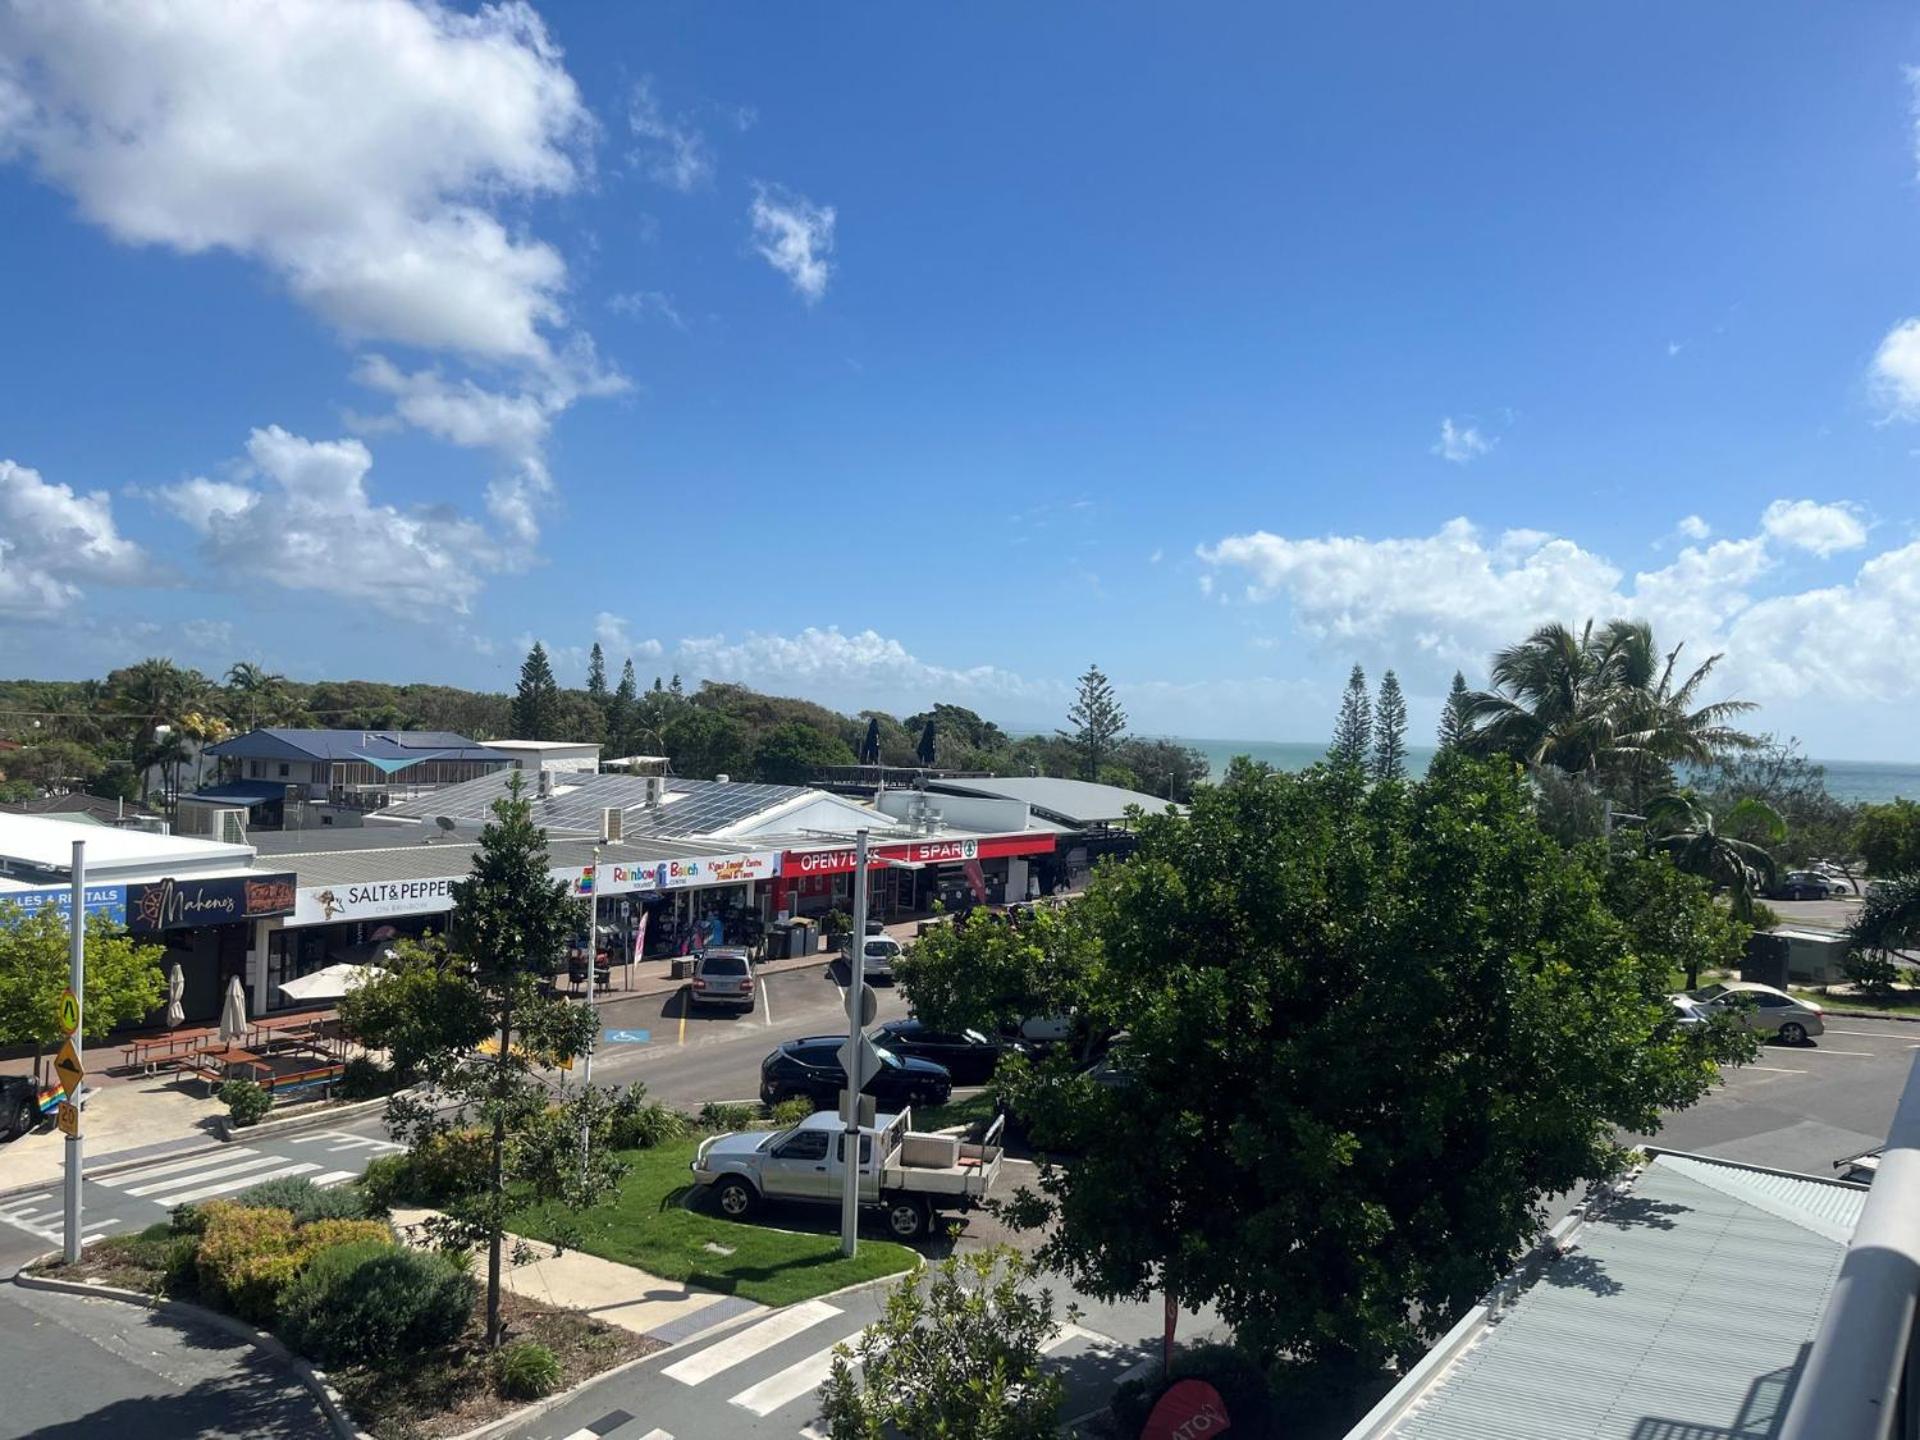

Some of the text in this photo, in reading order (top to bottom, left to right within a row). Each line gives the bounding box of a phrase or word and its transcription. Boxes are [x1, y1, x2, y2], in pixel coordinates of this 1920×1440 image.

[801, 849, 880, 871] OPEN 7 DYS
[919, 844, 962, 859] SPAR
[613, 862, 699, 883] Rainbow Beach
[58, 889, 118, 905] RTALS
